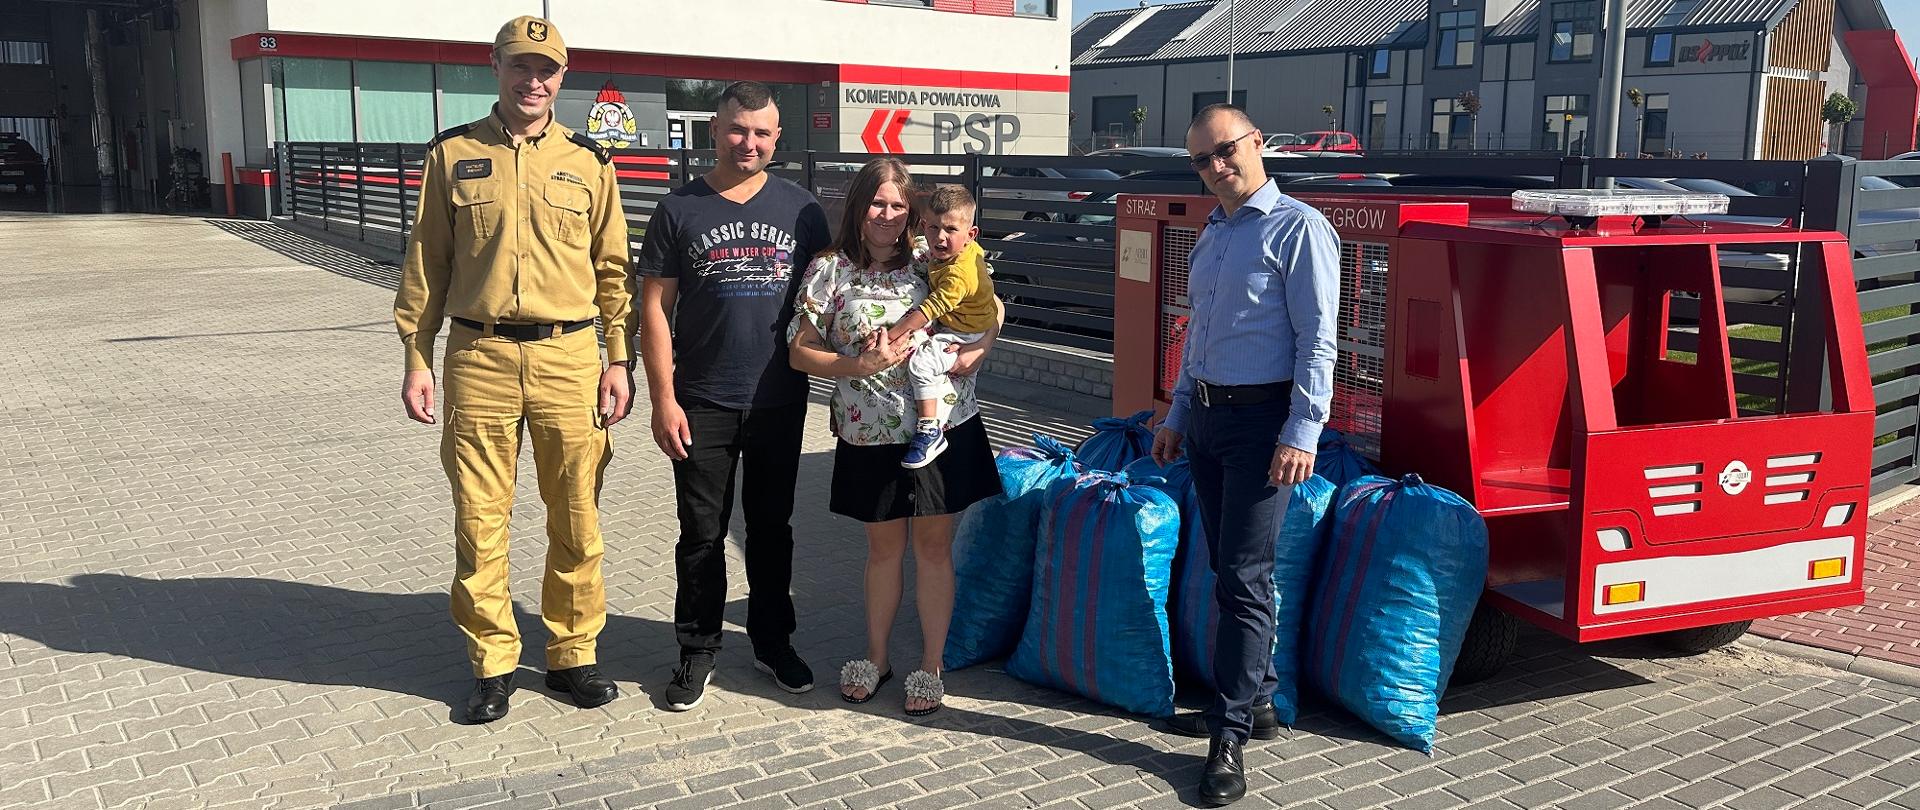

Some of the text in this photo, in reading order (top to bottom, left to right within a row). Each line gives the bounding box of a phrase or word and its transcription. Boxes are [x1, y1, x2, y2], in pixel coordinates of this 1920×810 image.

[260, 36, 277, 48] 83
[845, 88, 1001, 108] KOMENDA POWIATOWA
[933, 112, 1021, 155] PSP
[1320, 206, 1386, 230] GRÓW
[688, 221, 797, 260] CLASSIC SERIES
[710, 246, 776, 260] BLUE WATER CUP
